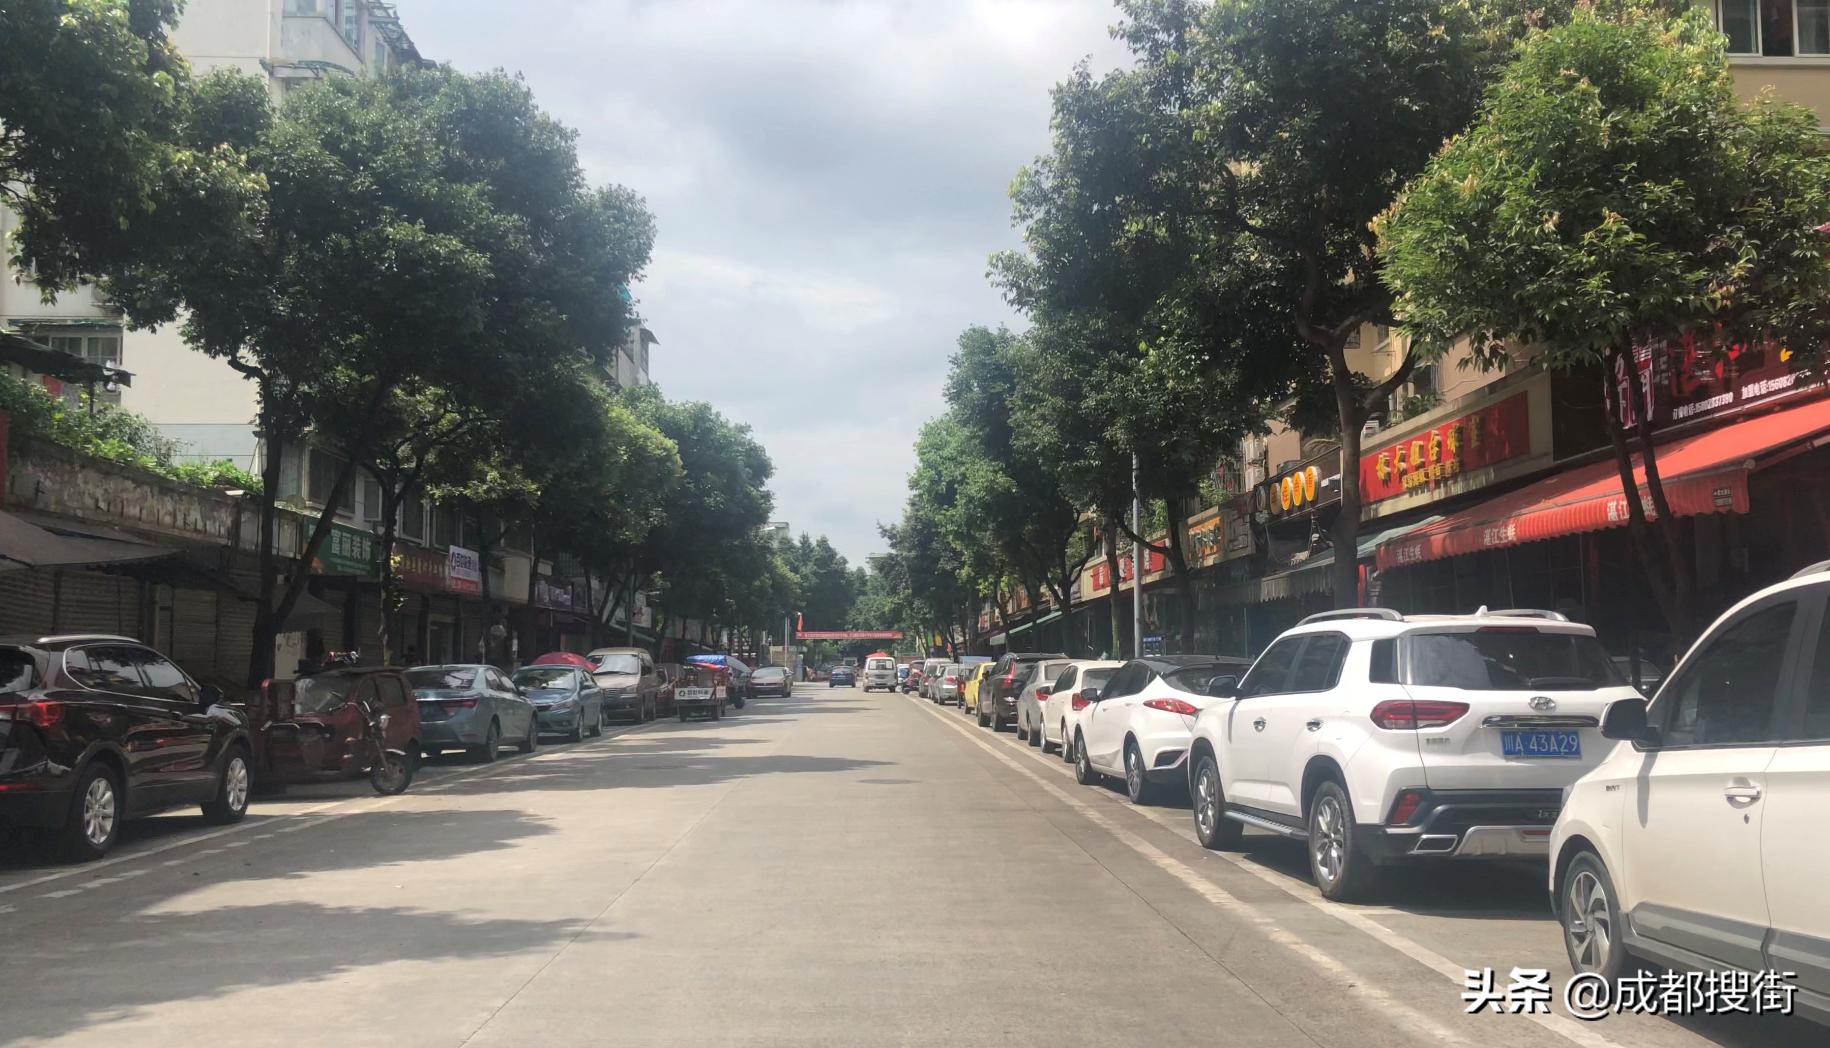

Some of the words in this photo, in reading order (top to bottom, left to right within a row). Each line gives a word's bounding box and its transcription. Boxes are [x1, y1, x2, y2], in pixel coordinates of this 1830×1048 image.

[1607, 496, 1657, 521] 湛江蚝
[1484, 523, 1516, 546] 湛江生蚝
